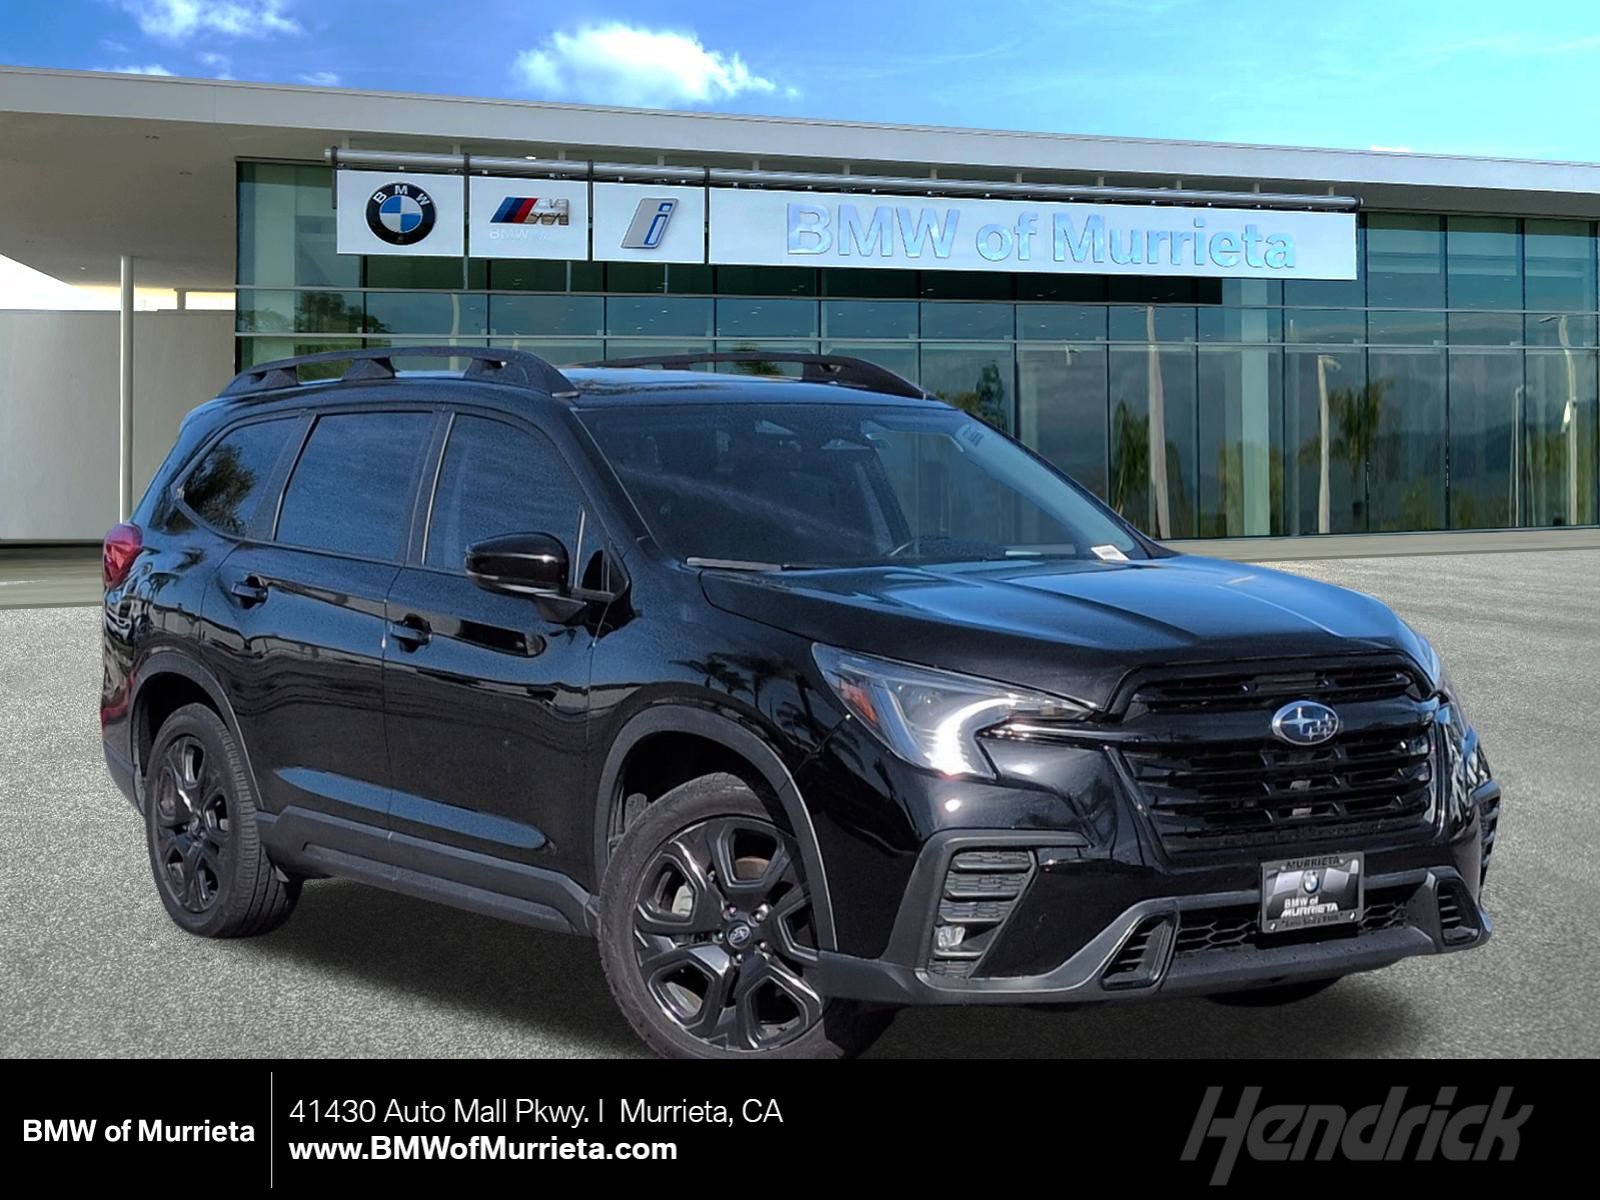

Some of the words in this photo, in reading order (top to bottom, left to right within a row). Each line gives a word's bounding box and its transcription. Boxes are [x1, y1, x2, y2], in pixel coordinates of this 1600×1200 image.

[373, 185, 430, 206] BMW
[787, 203, 960, 258] BMW
[976, 211, 1039, 262] of
[1053, 212, 1296, 269] Murrieta
[1286, 856, 1340, 870] MURRIETA
[1281, 902, 1339, 919] MURRIETA
[1284, 896, 1308, 909] BMW
